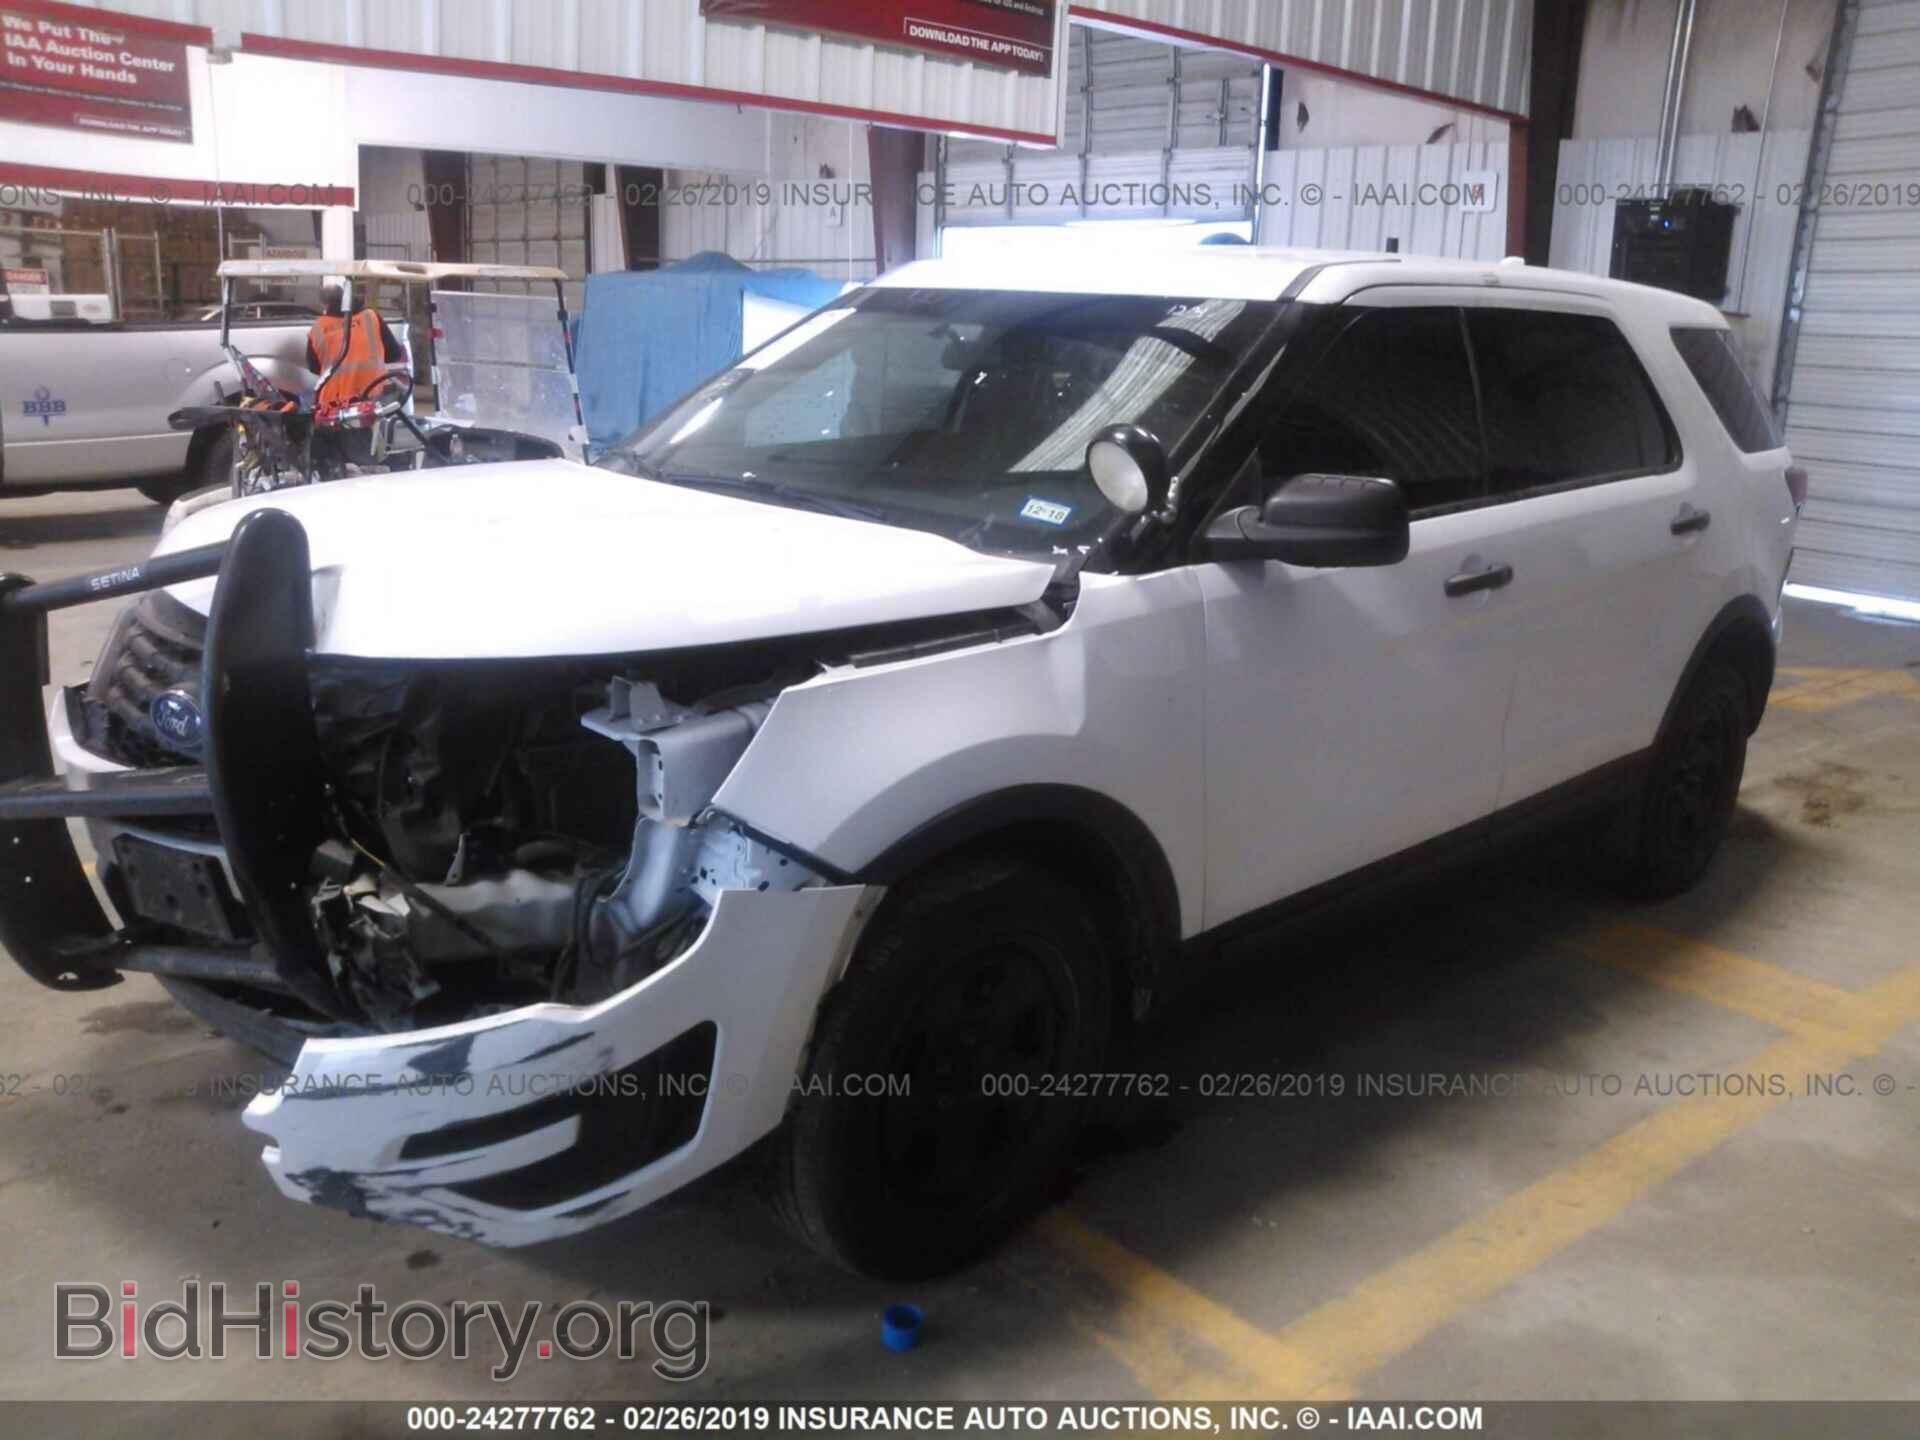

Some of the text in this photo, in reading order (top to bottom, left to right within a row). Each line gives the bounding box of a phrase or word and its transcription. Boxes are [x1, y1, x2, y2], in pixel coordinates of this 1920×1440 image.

[2, 14, 32, 31] We
[38, 20, 72, 39] Put
[4, 33, 176, 72] IAA Auction Center
[909, 25, 1044, 62] DOWNLOAD THE APP TODAY!
[7, 52, 137, 84] In Your Hands
[90, 567, 141, 592] SETINA
[159, 704, 190, 737] Ford
